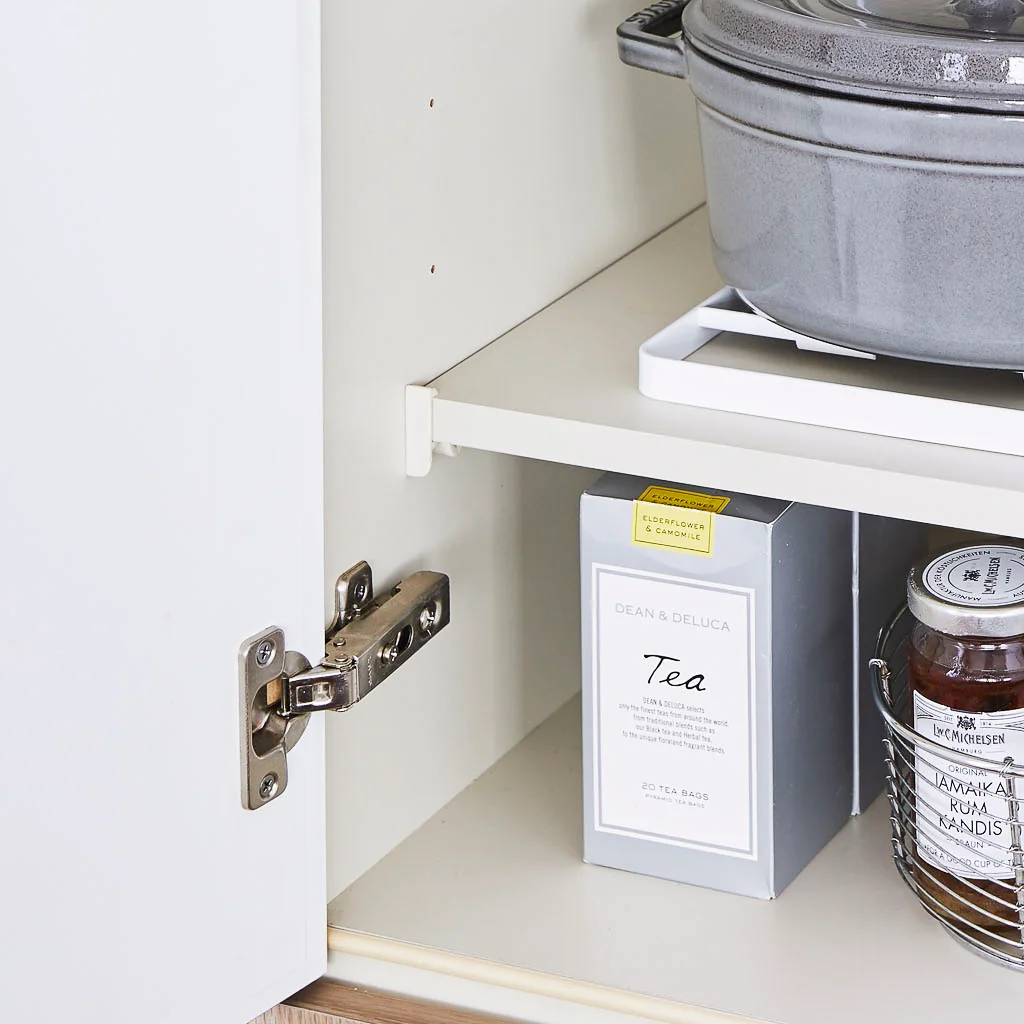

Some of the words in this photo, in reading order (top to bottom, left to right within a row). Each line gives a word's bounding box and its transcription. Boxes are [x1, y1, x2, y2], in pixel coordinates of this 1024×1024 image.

[652, 494, 714, 508] ELDERFLOWER
[643, 515, 705, 530] ELDERFLOWER
[656, 527, 701, 540] CAMOMILE
[615, 603, 654, 618] DEAN
[659, 610, 668, 621] &
[672, 612, 730, 632] DELUCA
[644, 654, 706, 691] Tea
[643, 697, 657, 705] DEAN
[664, 700, 685, 709] DELUCA
[686, 705, 705, 713] selects
[646, 725, 660, 733] Black
[948, 764, 989, 777] ORIGINAL
[642, 782, 656, 791] 20
[659, 785, 677, 795] TEA
[681, 789, 709, 801] BAGS
[950, 798, 988, 816] RUM
[939, 815, 1003, 836] KANDIS
[976, 860, 991, 868] CUP
